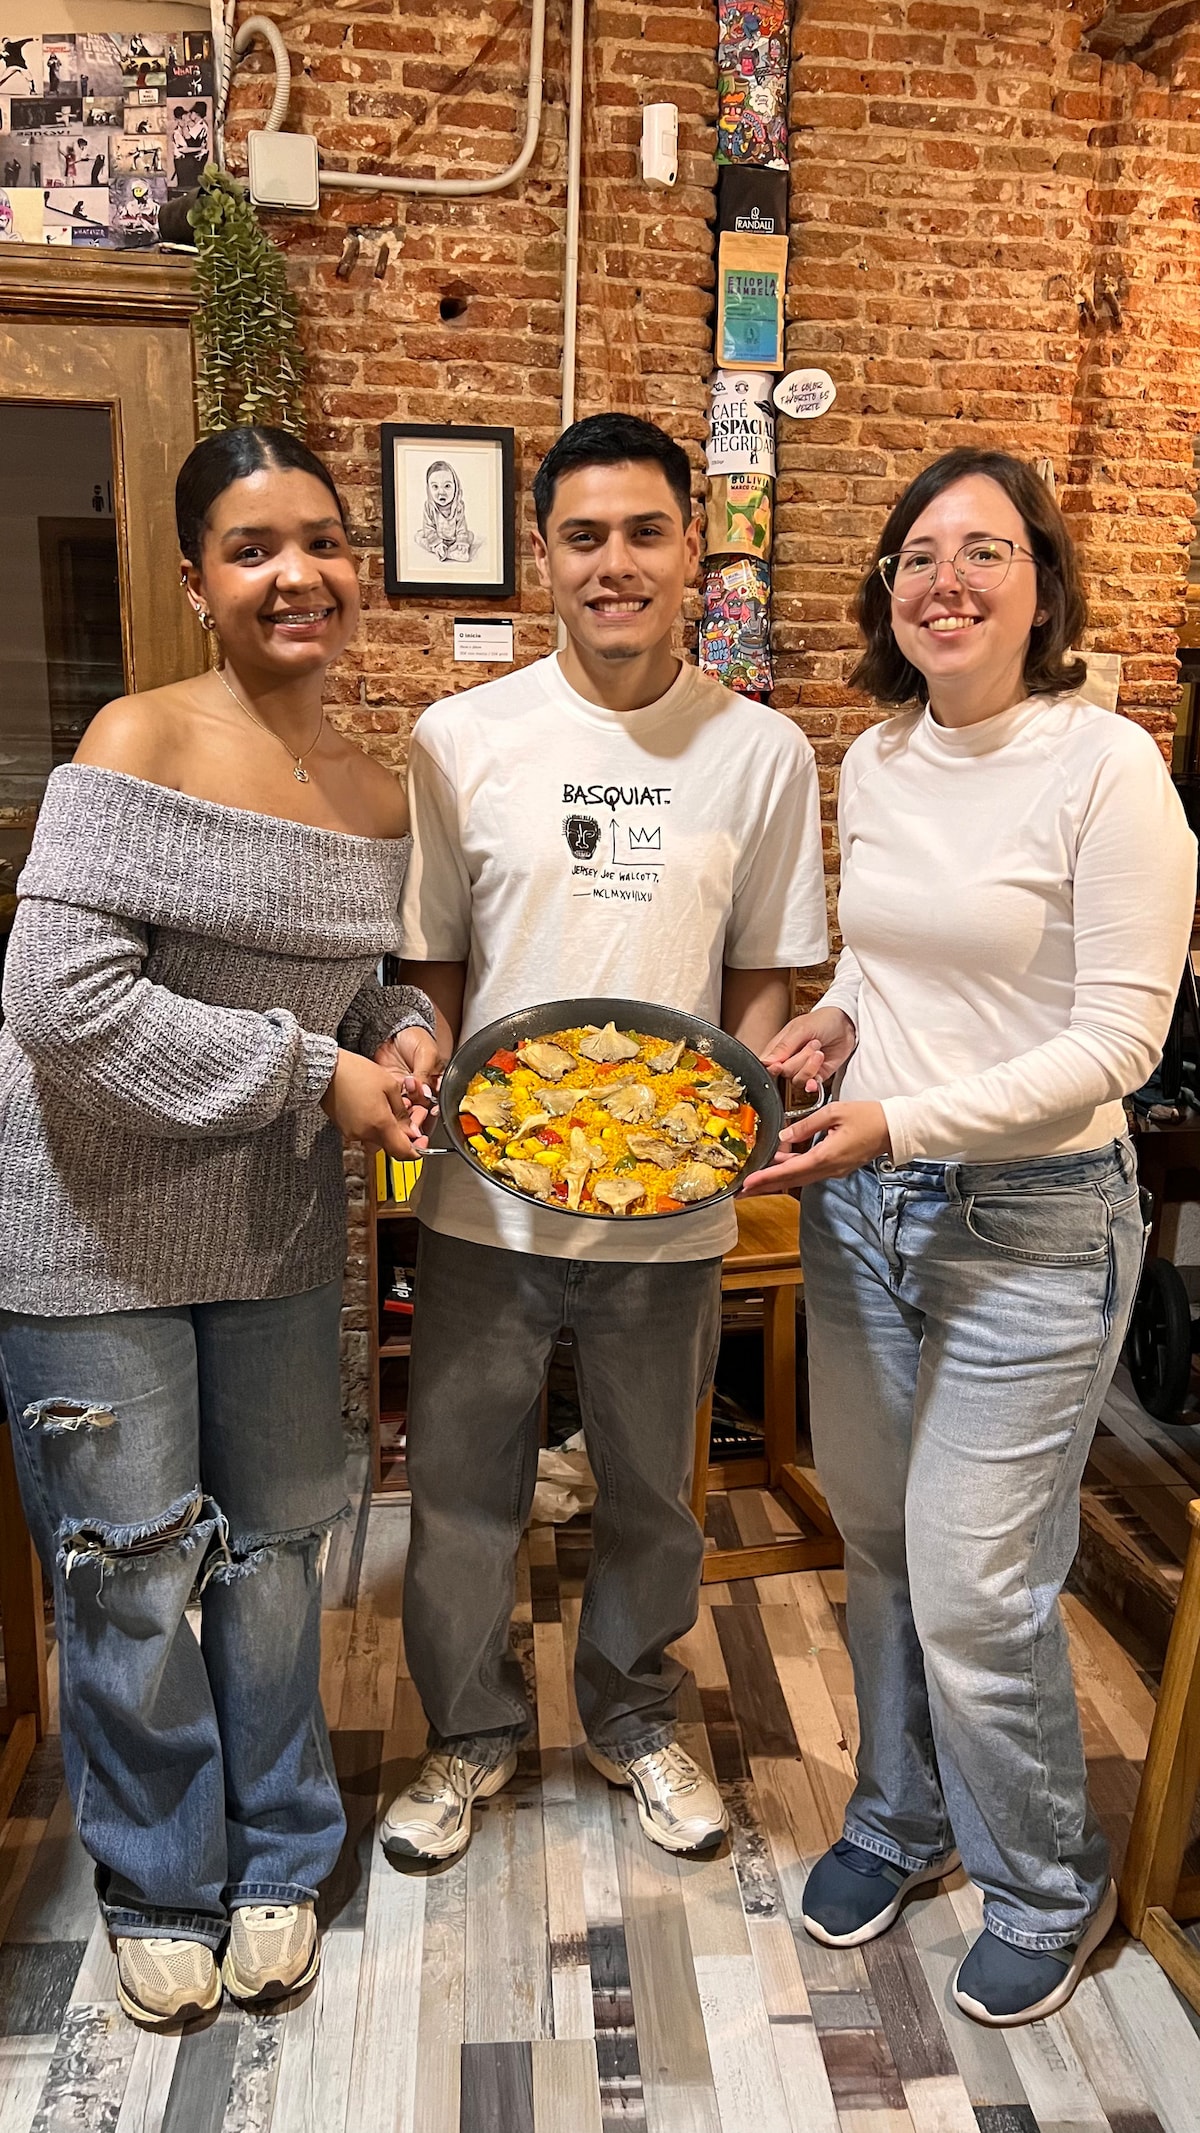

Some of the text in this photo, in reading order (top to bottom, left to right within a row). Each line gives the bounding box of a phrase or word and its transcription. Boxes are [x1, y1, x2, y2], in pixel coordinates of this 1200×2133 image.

[737, 220, 772, 230] RANDALL
[728, 275, 776, 288] ETIOPÍA
[711, 398, 748, 421] CAFÉ
[711, 419, 774, 439] ESPACIAL
[711, 434, 775, 455] TEGRIDAD
[731, 475, 769, 489] BOLIVIA
[571, 865, 598, 878] JERSEY
[600, 869, 615, 880] JOE
